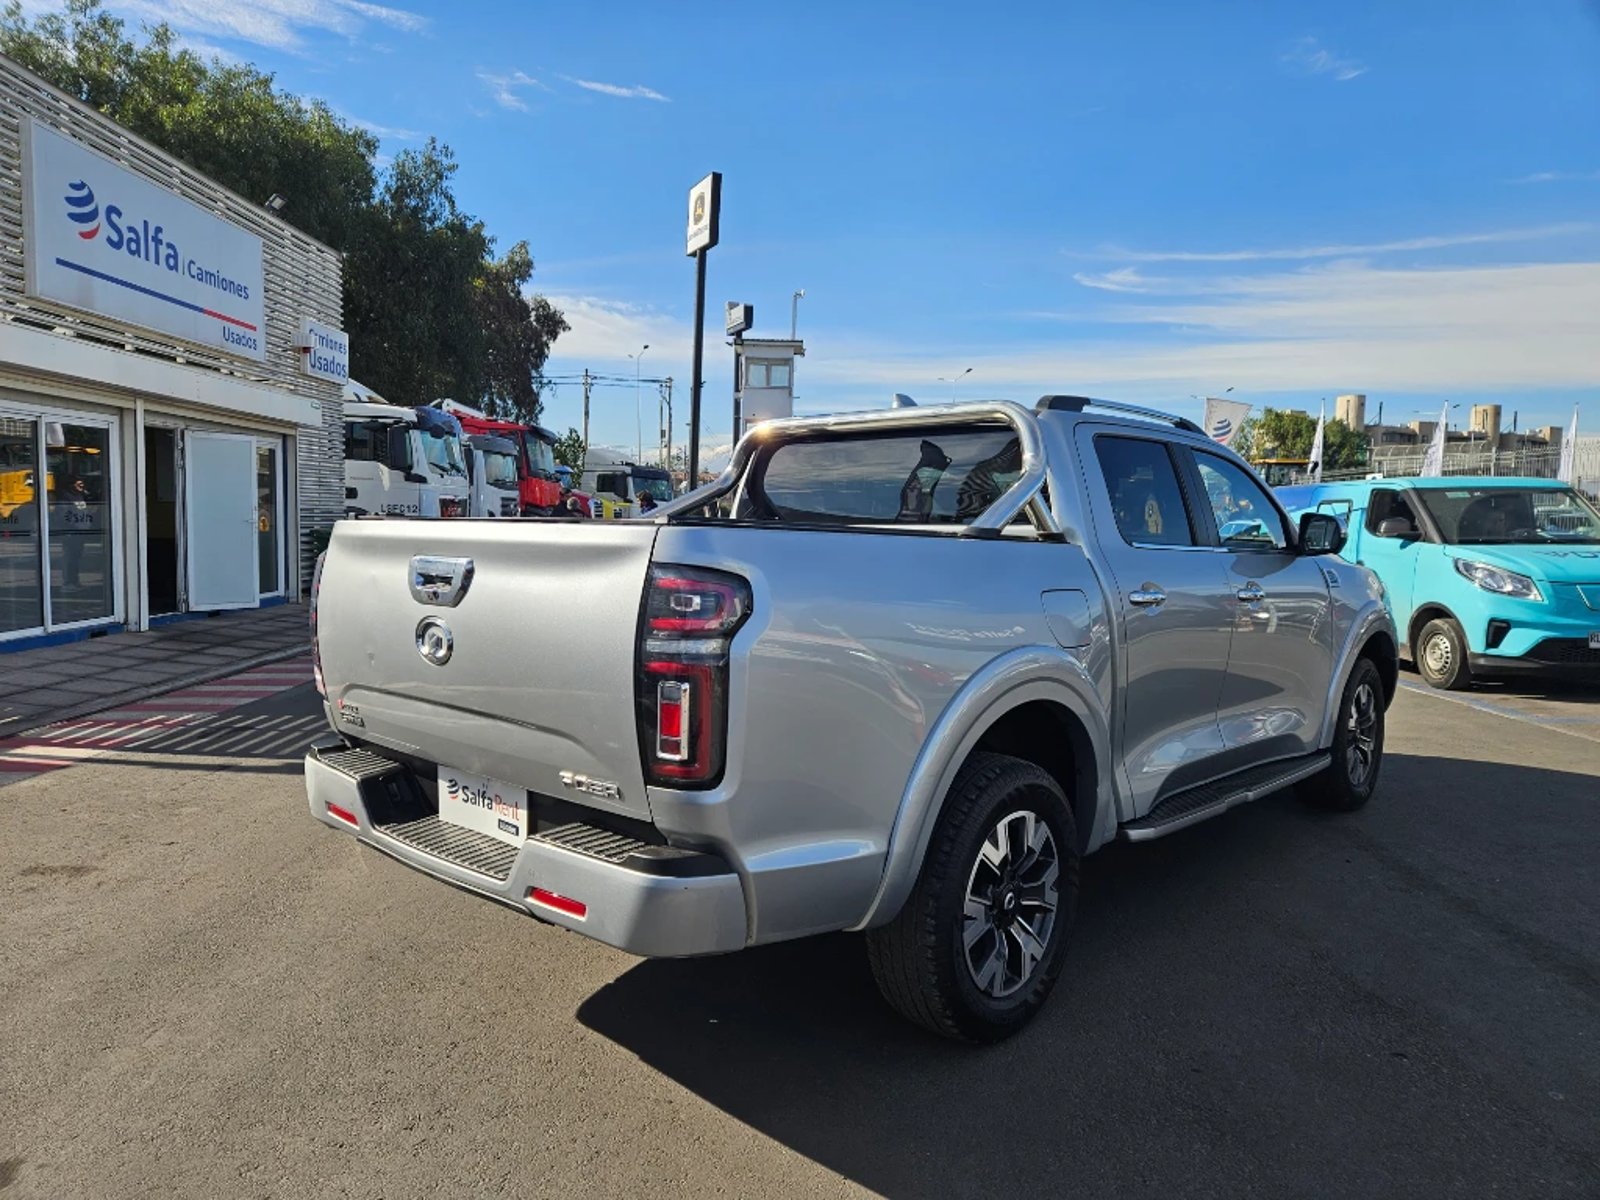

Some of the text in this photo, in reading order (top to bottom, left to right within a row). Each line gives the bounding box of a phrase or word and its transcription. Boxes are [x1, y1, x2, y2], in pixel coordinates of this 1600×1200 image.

[105, 204, 249, 300] Salfa Camiones
[223, 325, 257, 350] Usados
[309, 329, 347, 355] miones
[309, 350, 347, 378] Usados
